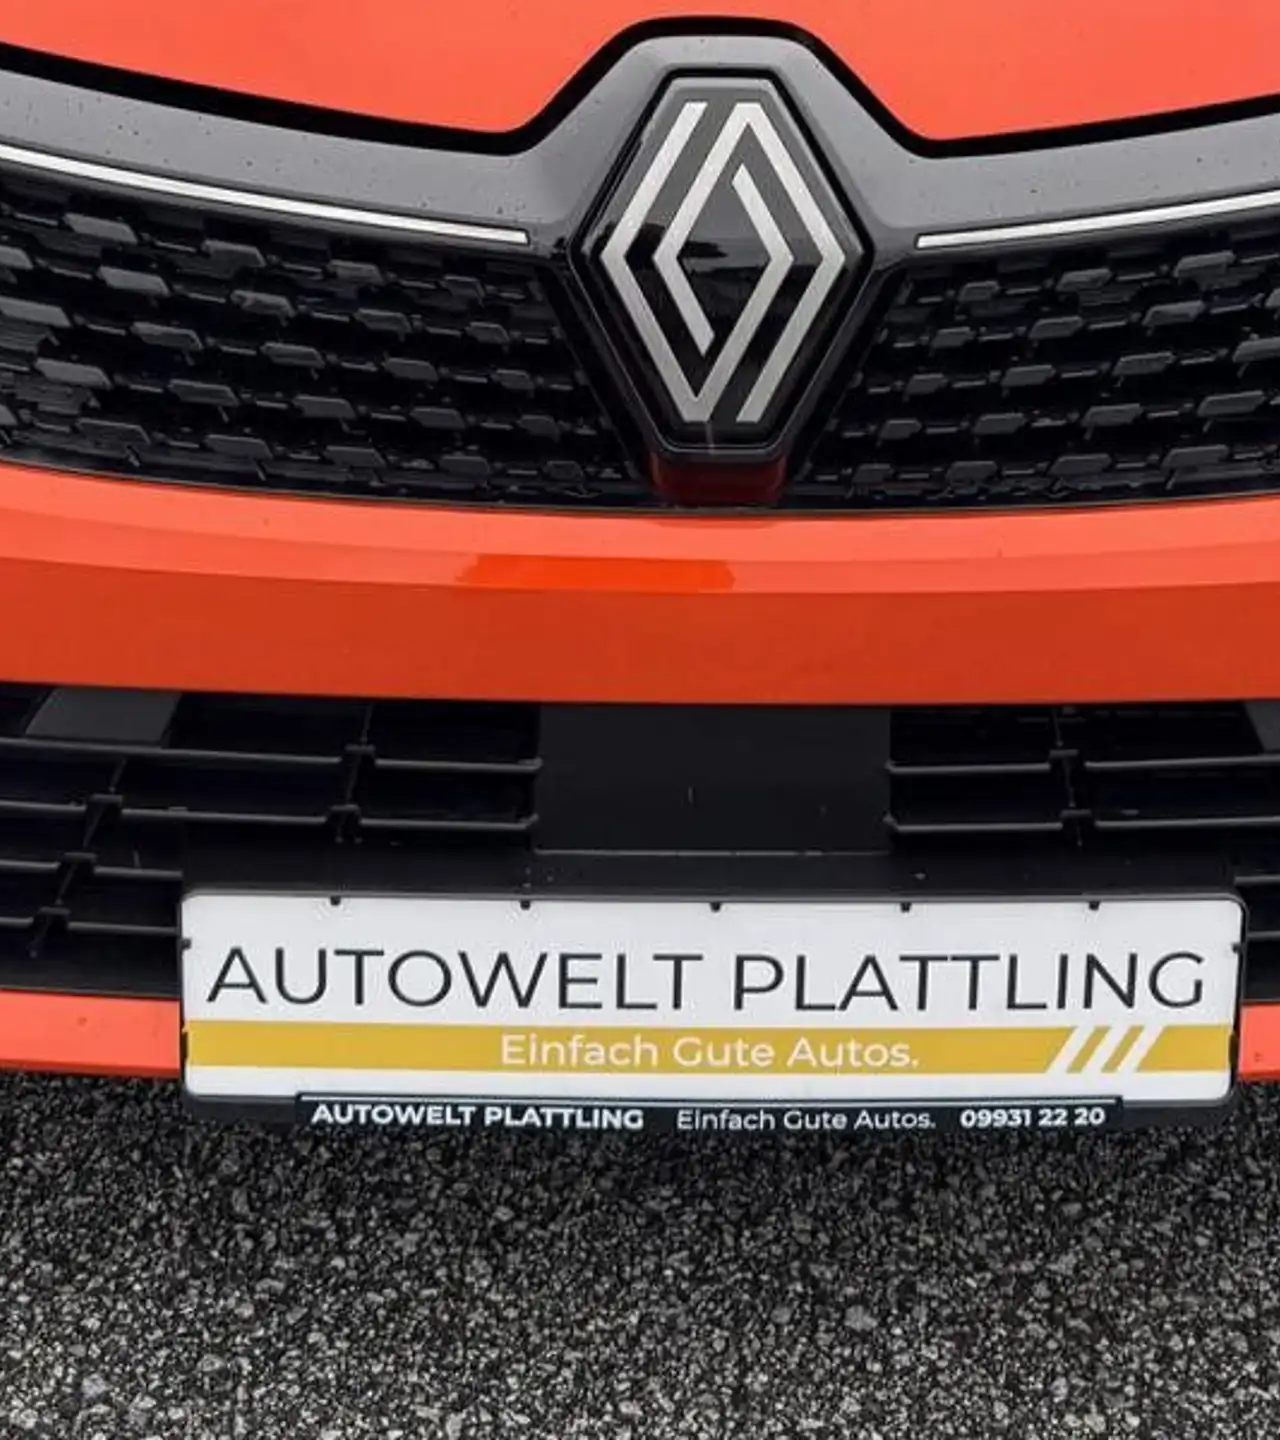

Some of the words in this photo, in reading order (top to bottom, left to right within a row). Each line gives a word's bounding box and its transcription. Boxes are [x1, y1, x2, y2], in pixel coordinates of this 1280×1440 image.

[206, 947, 704, 1010] AUTOWELT
[734, 953, 1204, 1011] PLATTLING
[502, 1034, 658, 1066] Einfach
[672, 1037, 775, 1067] Gute
[786, 1036, 919, 1068] Autos.
[311, 1103, 478, 1126] AUTOWELT
[484, 1105, 644, 1130] PLATTLING
[677, 1109, 776, 1131] Einfach
[783, 1110, 848, 1131] Gute
[853, 1109, 936, 1130] Autos.
[959, 1108, 1032, 1130] 09931
[1038, 1108, 1068, 1128] 22
[1074, 1106, 1106, 1127] 20
